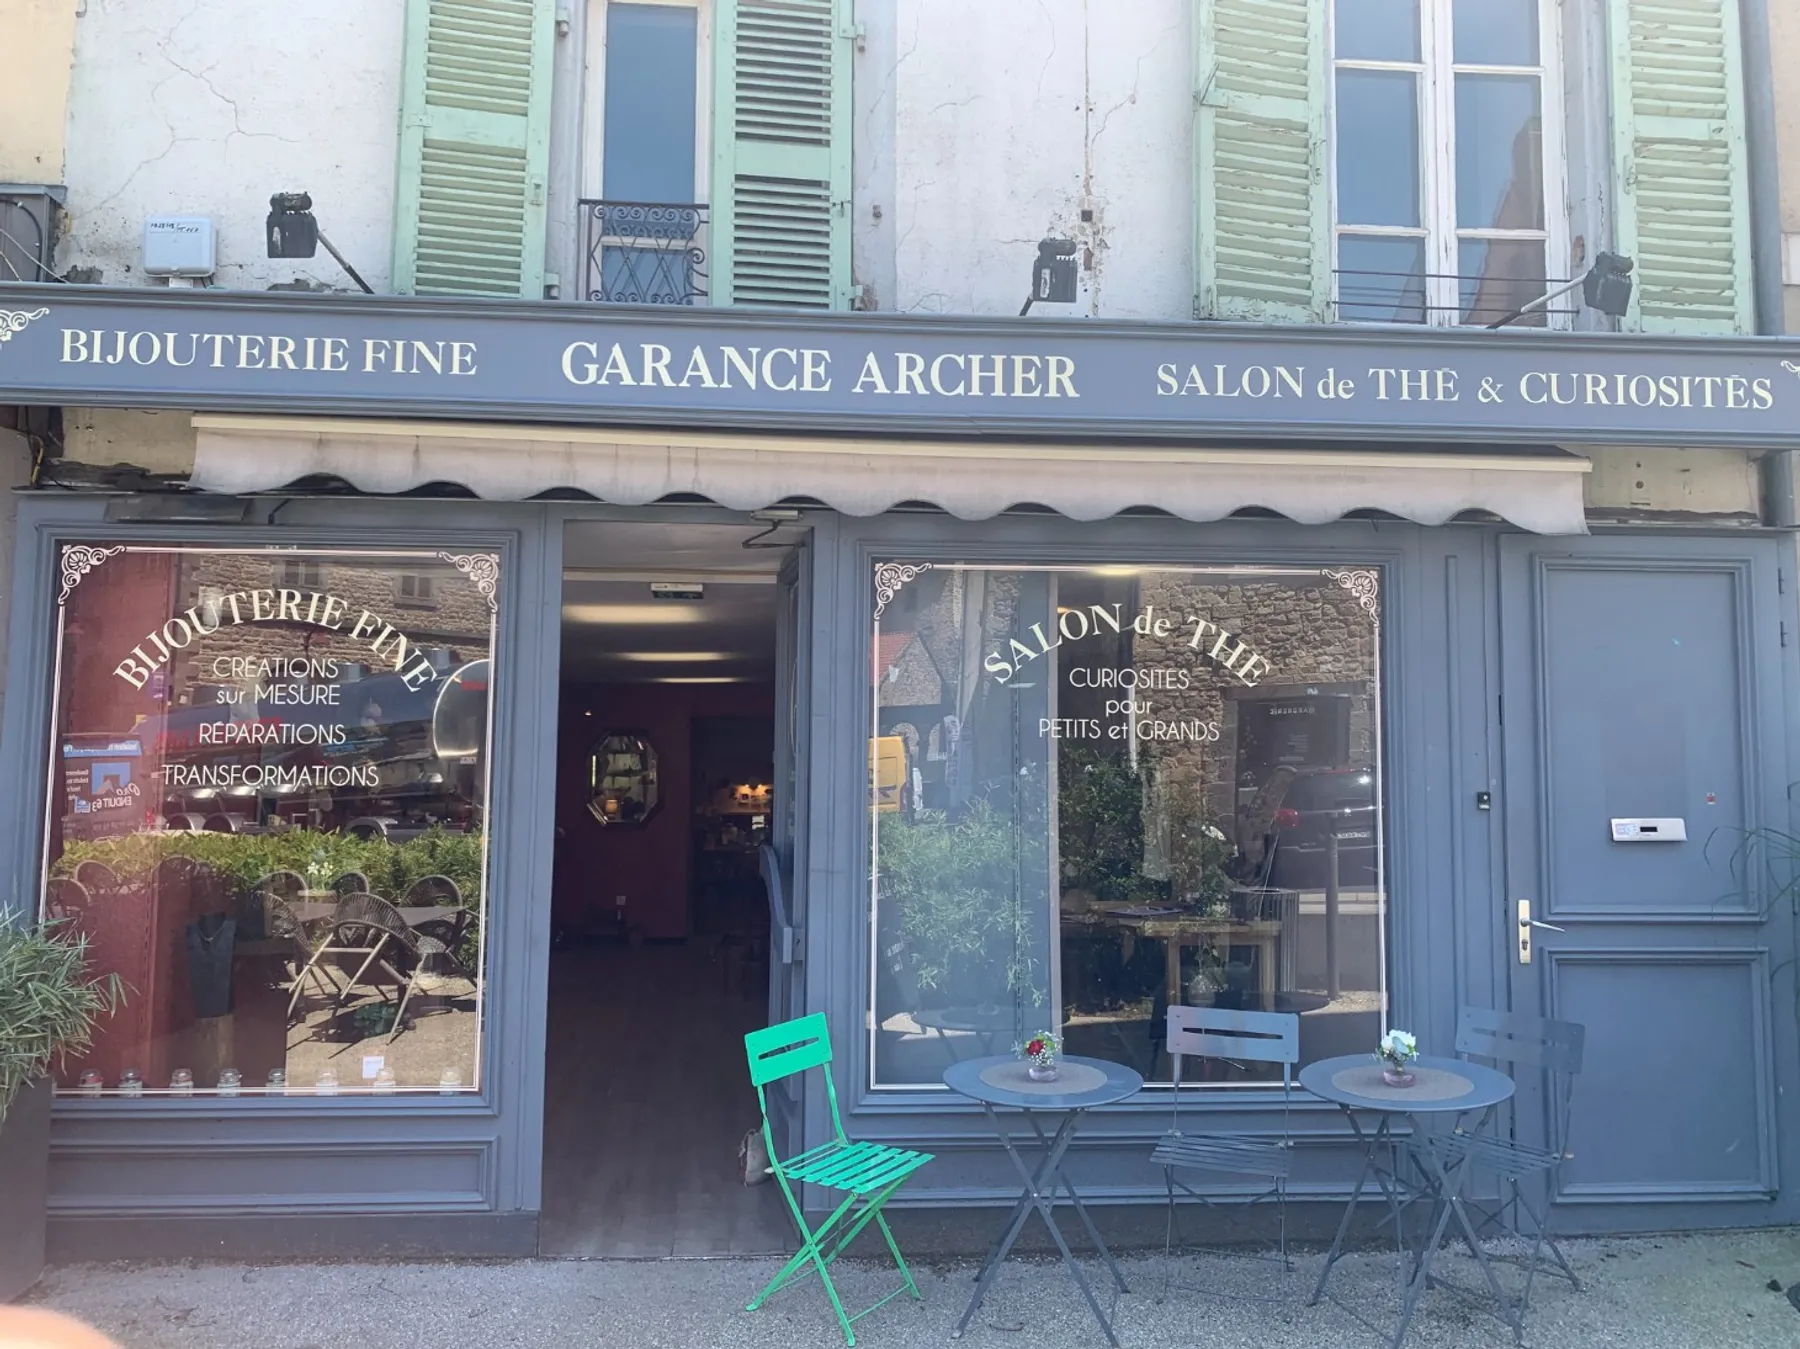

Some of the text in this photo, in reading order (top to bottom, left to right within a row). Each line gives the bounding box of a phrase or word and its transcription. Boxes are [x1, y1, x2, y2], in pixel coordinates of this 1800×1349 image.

[60, 328, 478, 376] BIJOUTERIE FINE
[561, 341, 1080, 398] GARANCE ARCHER
[1156, 363, 1306, 398] SALON
[1316, 367, 1355, 400] de
[1477, 376, 1505, 404] &
[113, 588, 438, 693] BIJOUTERIE FINE
[984, 603, 1123, 685] SALON
[1133, 605, 1171, 637] de
[216, 684, 341, 705] sur MESURE
[1105, 699, 1153, 718] pour
[199, 720, 347, 745] RÉPARATIONS
[1039, 718, 1220, 742] PETITS et GRANDS
[161, 764, 380, 787] TRANSFORMATIONS
